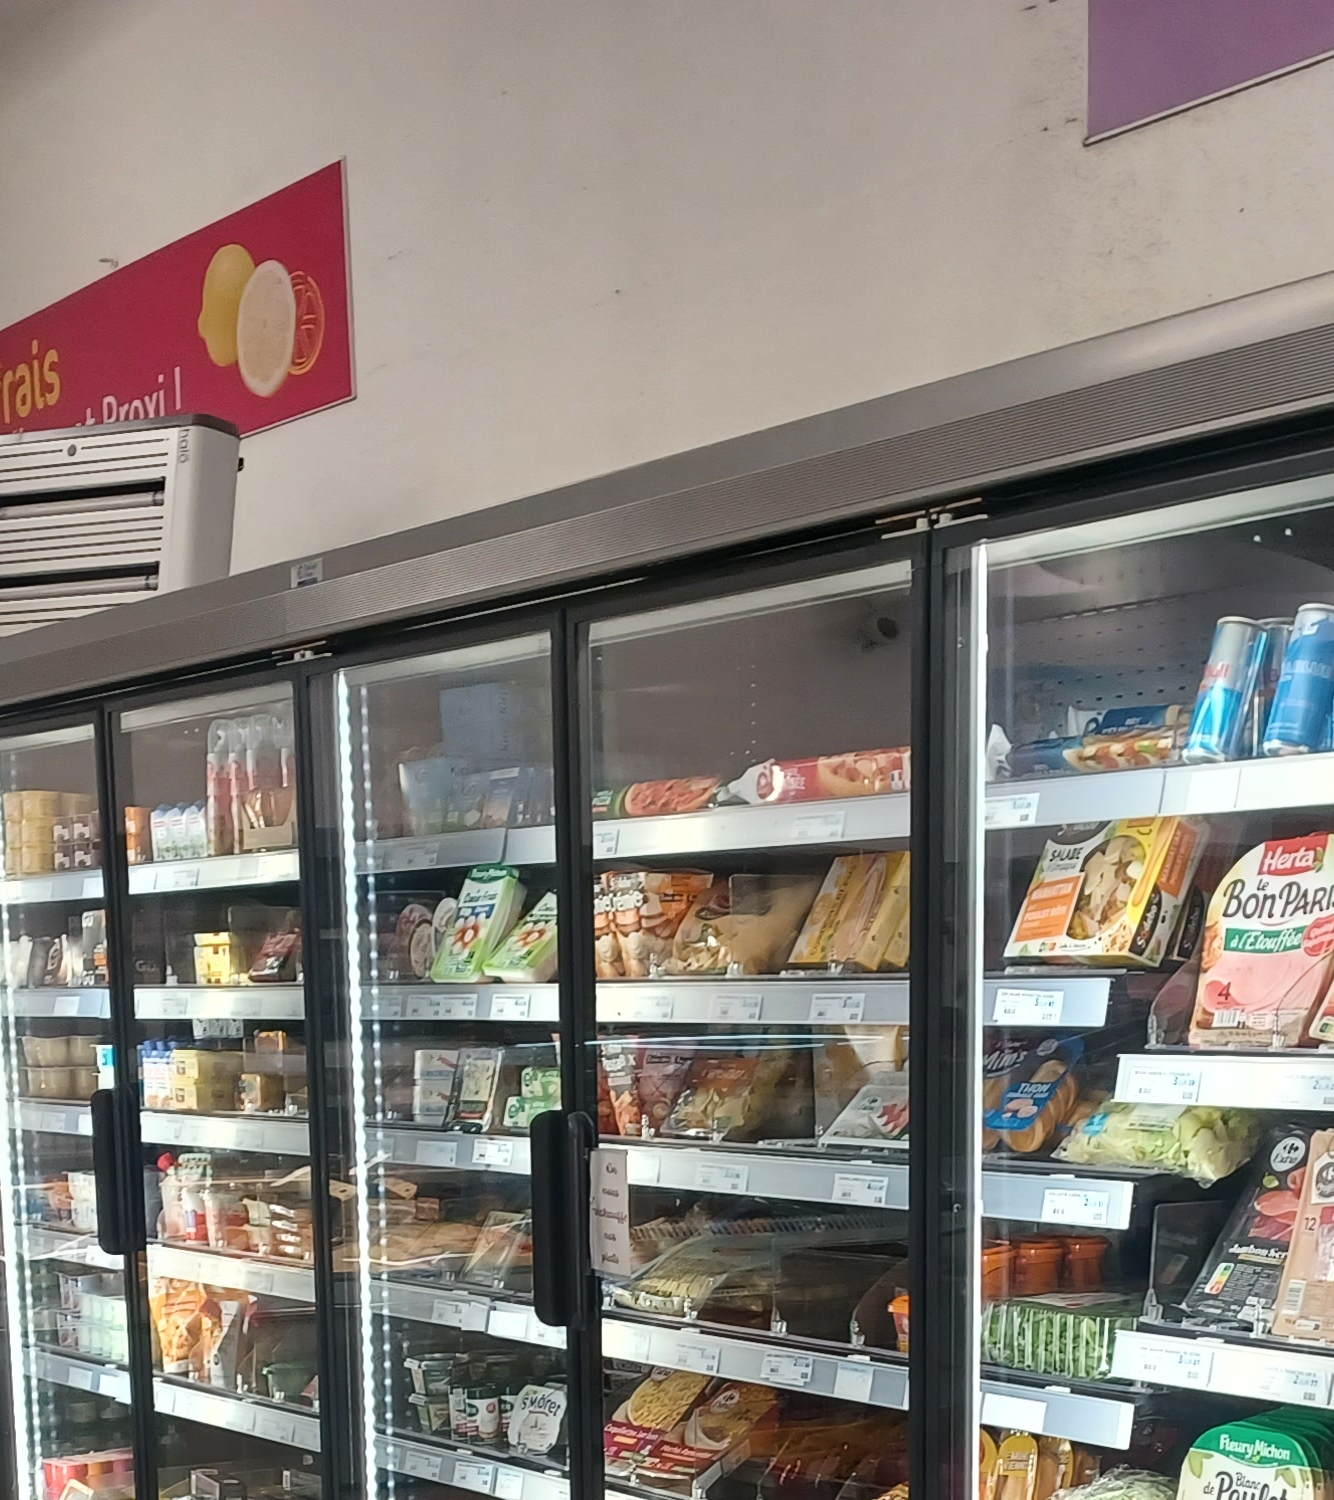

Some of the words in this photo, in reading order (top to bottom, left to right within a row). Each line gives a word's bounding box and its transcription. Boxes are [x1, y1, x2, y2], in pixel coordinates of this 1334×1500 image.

[1263, 841, 1315, 872] Herta
[1218, 981, 1231, 1000] 4
[1017, 1082, 1052, 1094] THON
[1304, 1217, 1317, 1232] 12
[1219, 1433, 1254, 1457] Fleury
[1254, 1439, 1291, 1462] Michon
[1203, 1482, 1215, 1496] de
[1235, 1471, 1262, 1490] Blanc
